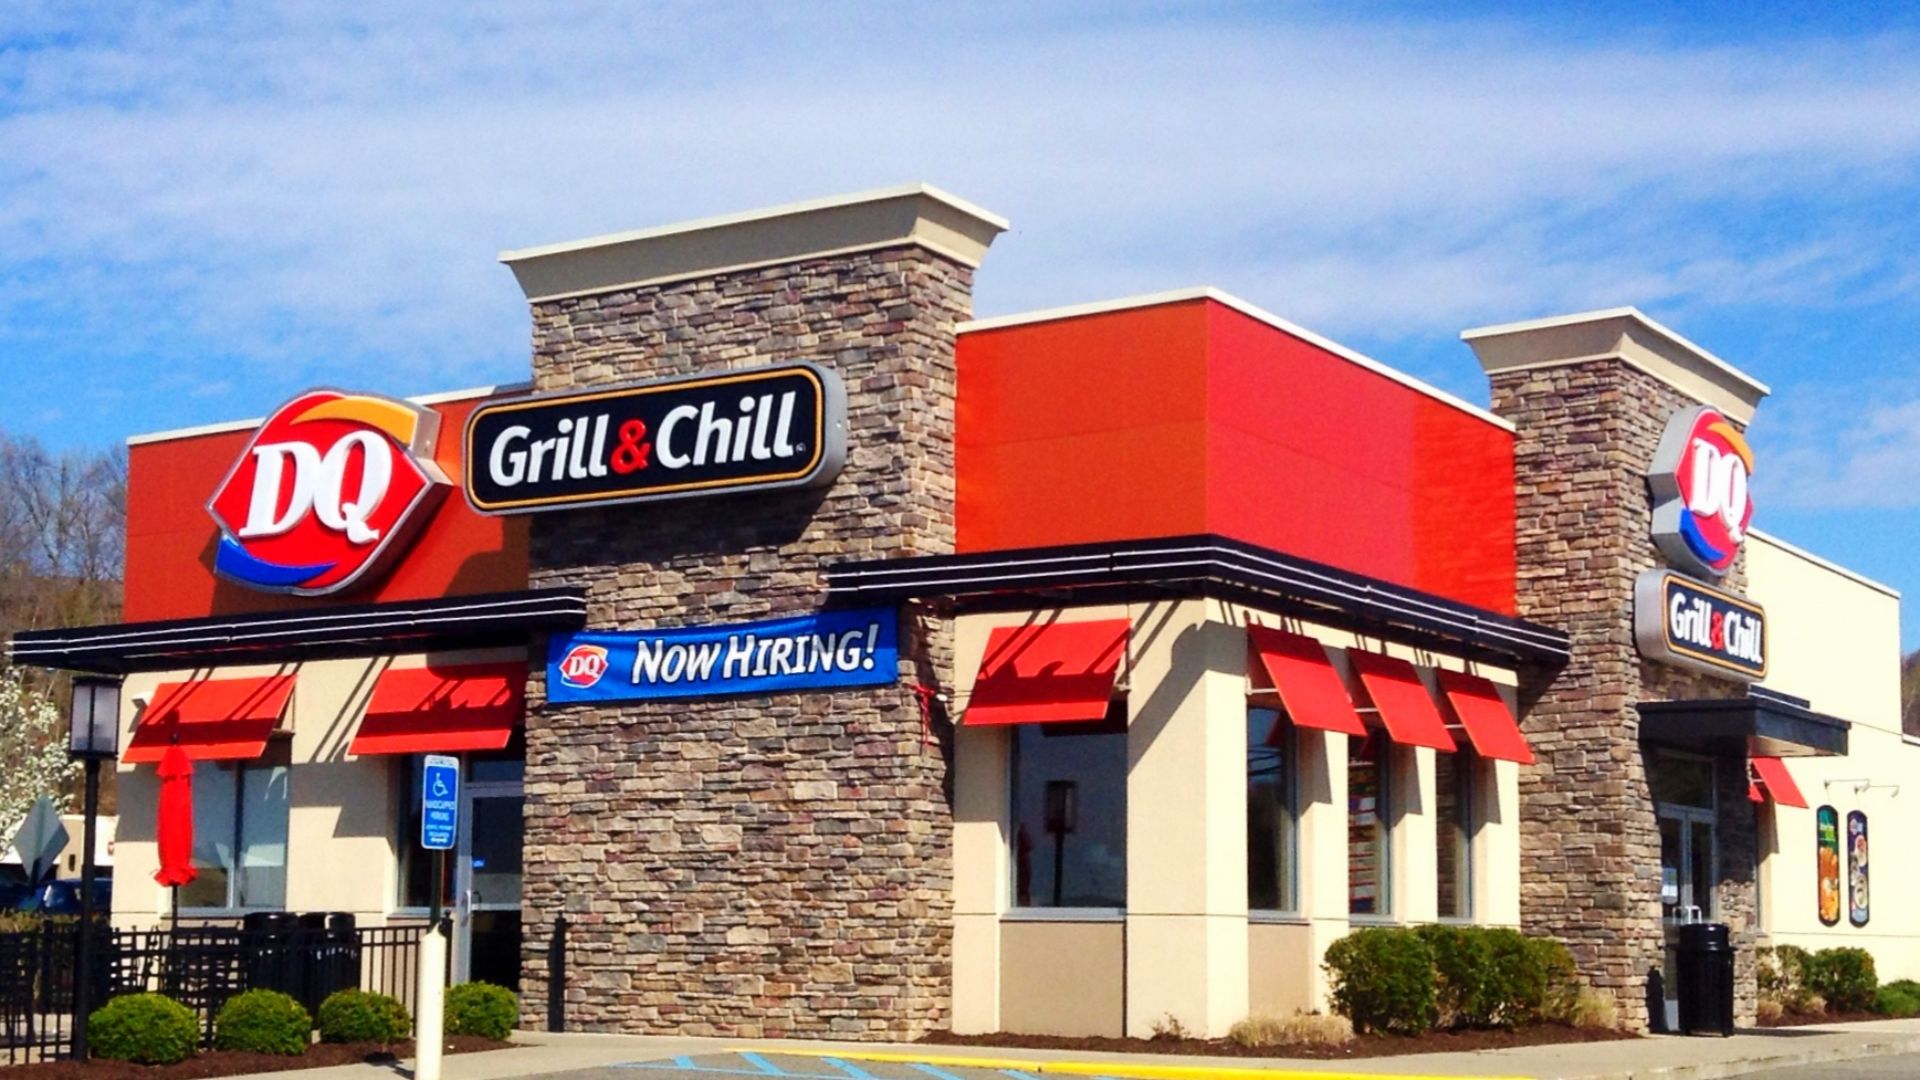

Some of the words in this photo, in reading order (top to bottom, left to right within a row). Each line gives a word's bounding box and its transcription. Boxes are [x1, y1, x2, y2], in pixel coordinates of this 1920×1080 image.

[238, 429, 393, 545] DQ
[489, 413, 610, 487] Grill
[610, 419, 651, 475] &
[655, 391, 797, 469] Chill
[1691, 437, 1748, 544] DQ
[568, 654, 601, 678] DQ
[1670, 592, 1712, 648] Grill
[1723, 610, 1763, 664] Chill
